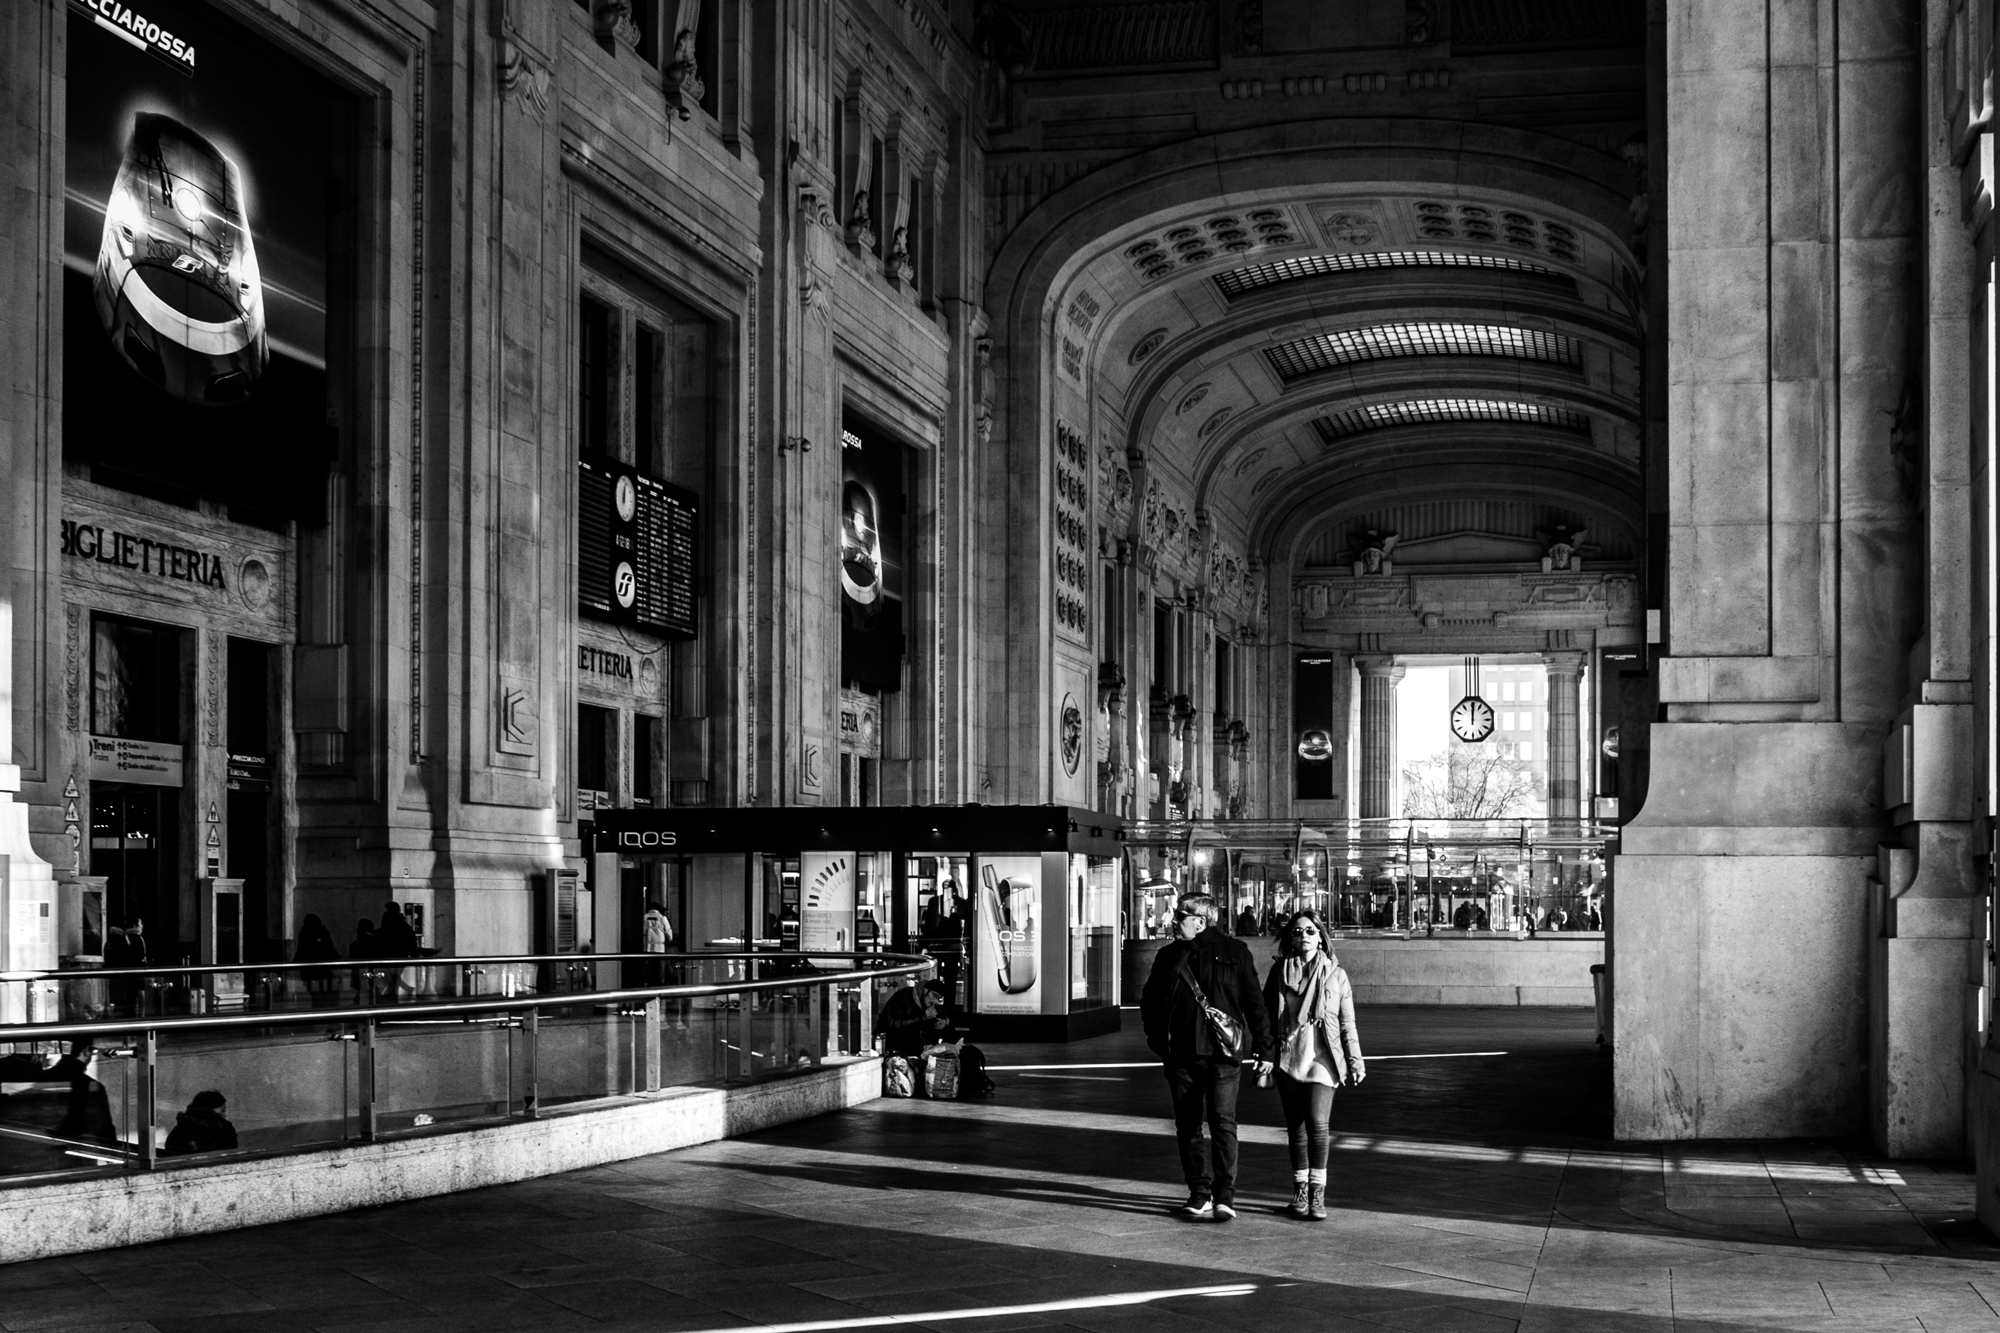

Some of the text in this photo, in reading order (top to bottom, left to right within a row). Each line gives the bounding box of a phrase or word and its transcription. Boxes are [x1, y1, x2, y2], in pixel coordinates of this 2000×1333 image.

[81, 0, 195, 67] CCIAROSSA
[93, 738, 115, 752] Treni
[619, 831, 676, 849] IQOS
